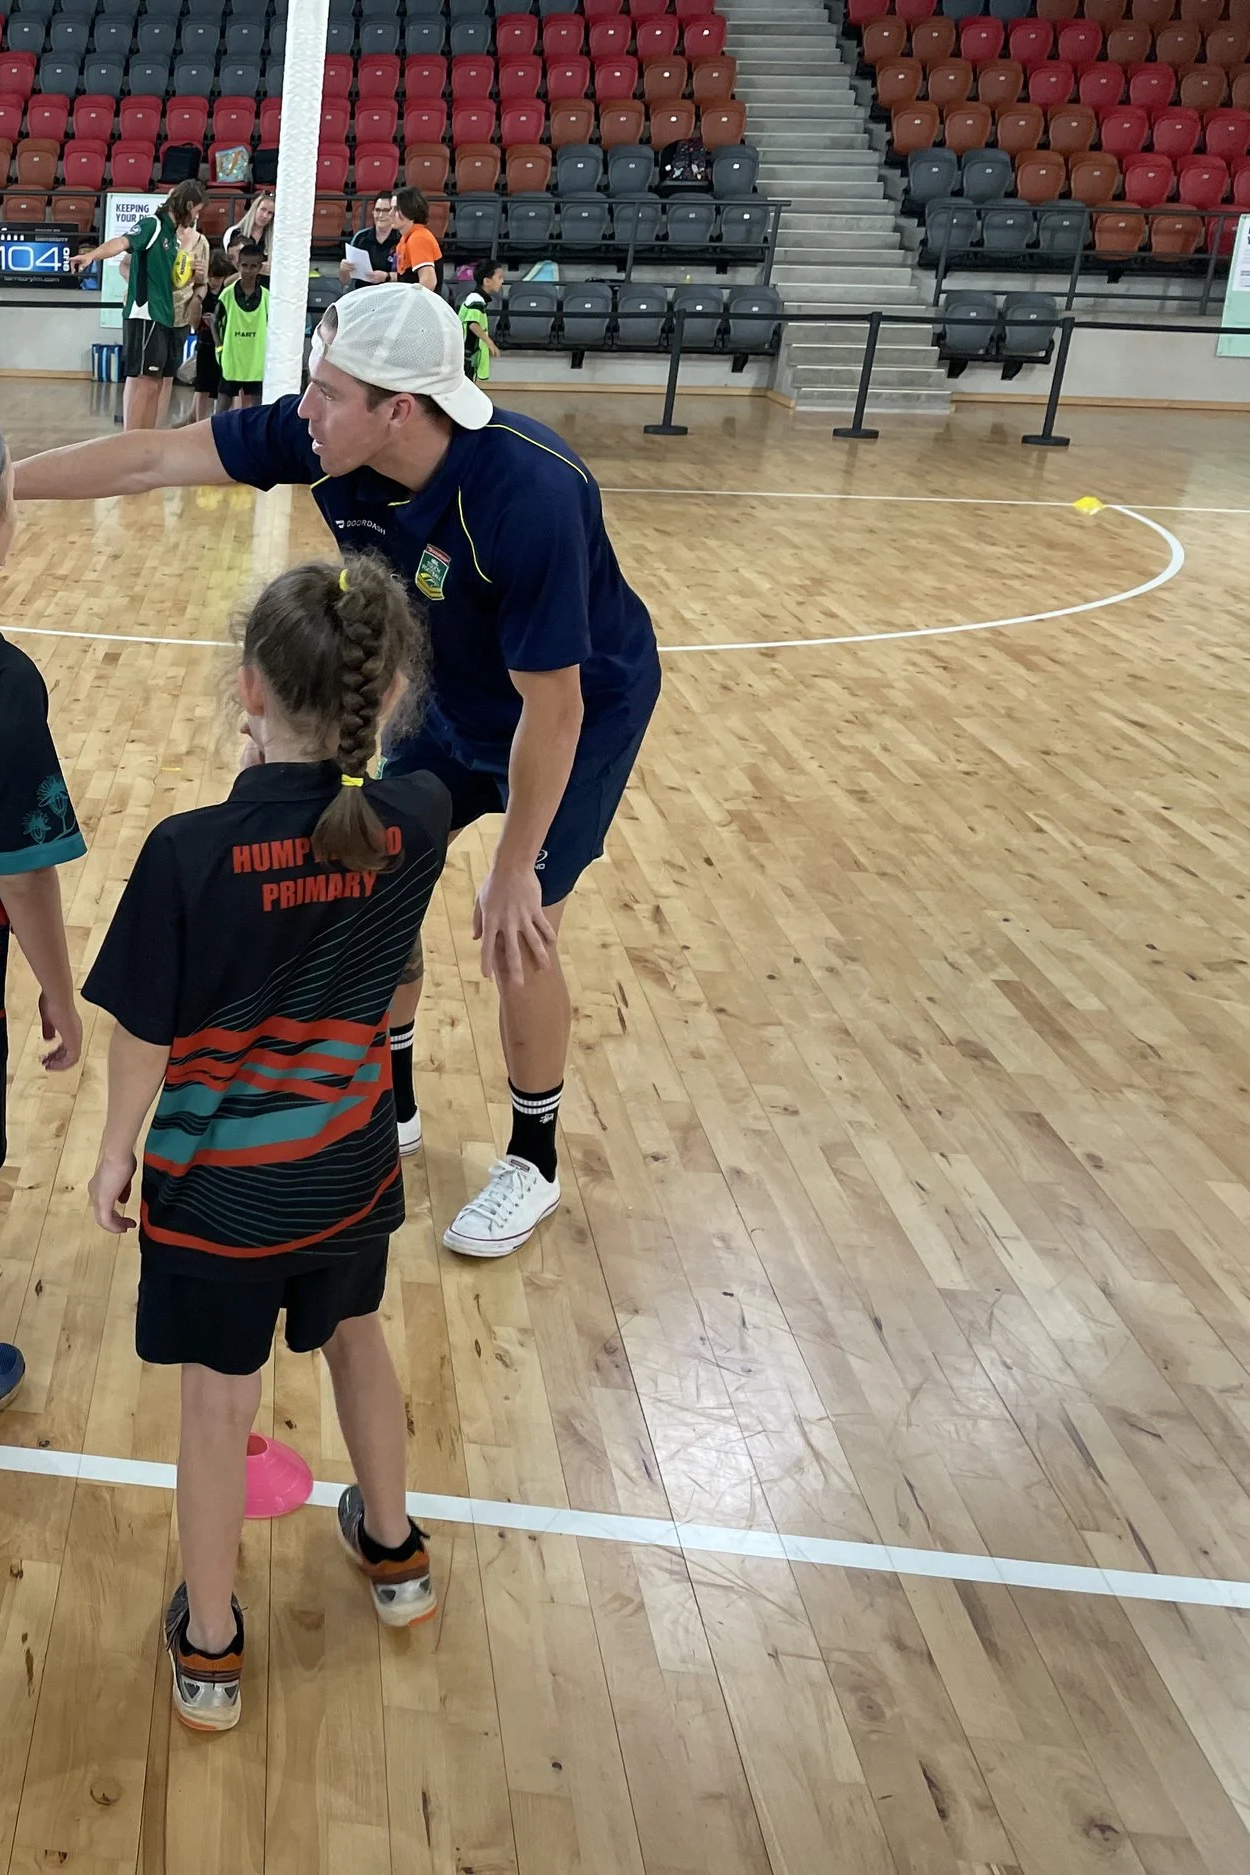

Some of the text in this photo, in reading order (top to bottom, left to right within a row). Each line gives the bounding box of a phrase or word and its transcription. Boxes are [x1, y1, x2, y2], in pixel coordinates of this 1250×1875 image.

[116, 204, 149, 213] KEEPING
[116, 213, 136, 222] YOUR
[346, 519, 386, 535] DOORDASH
[232, 837, 342, 874] HUMP
[262, 871, 378, 912] PRIMARY
